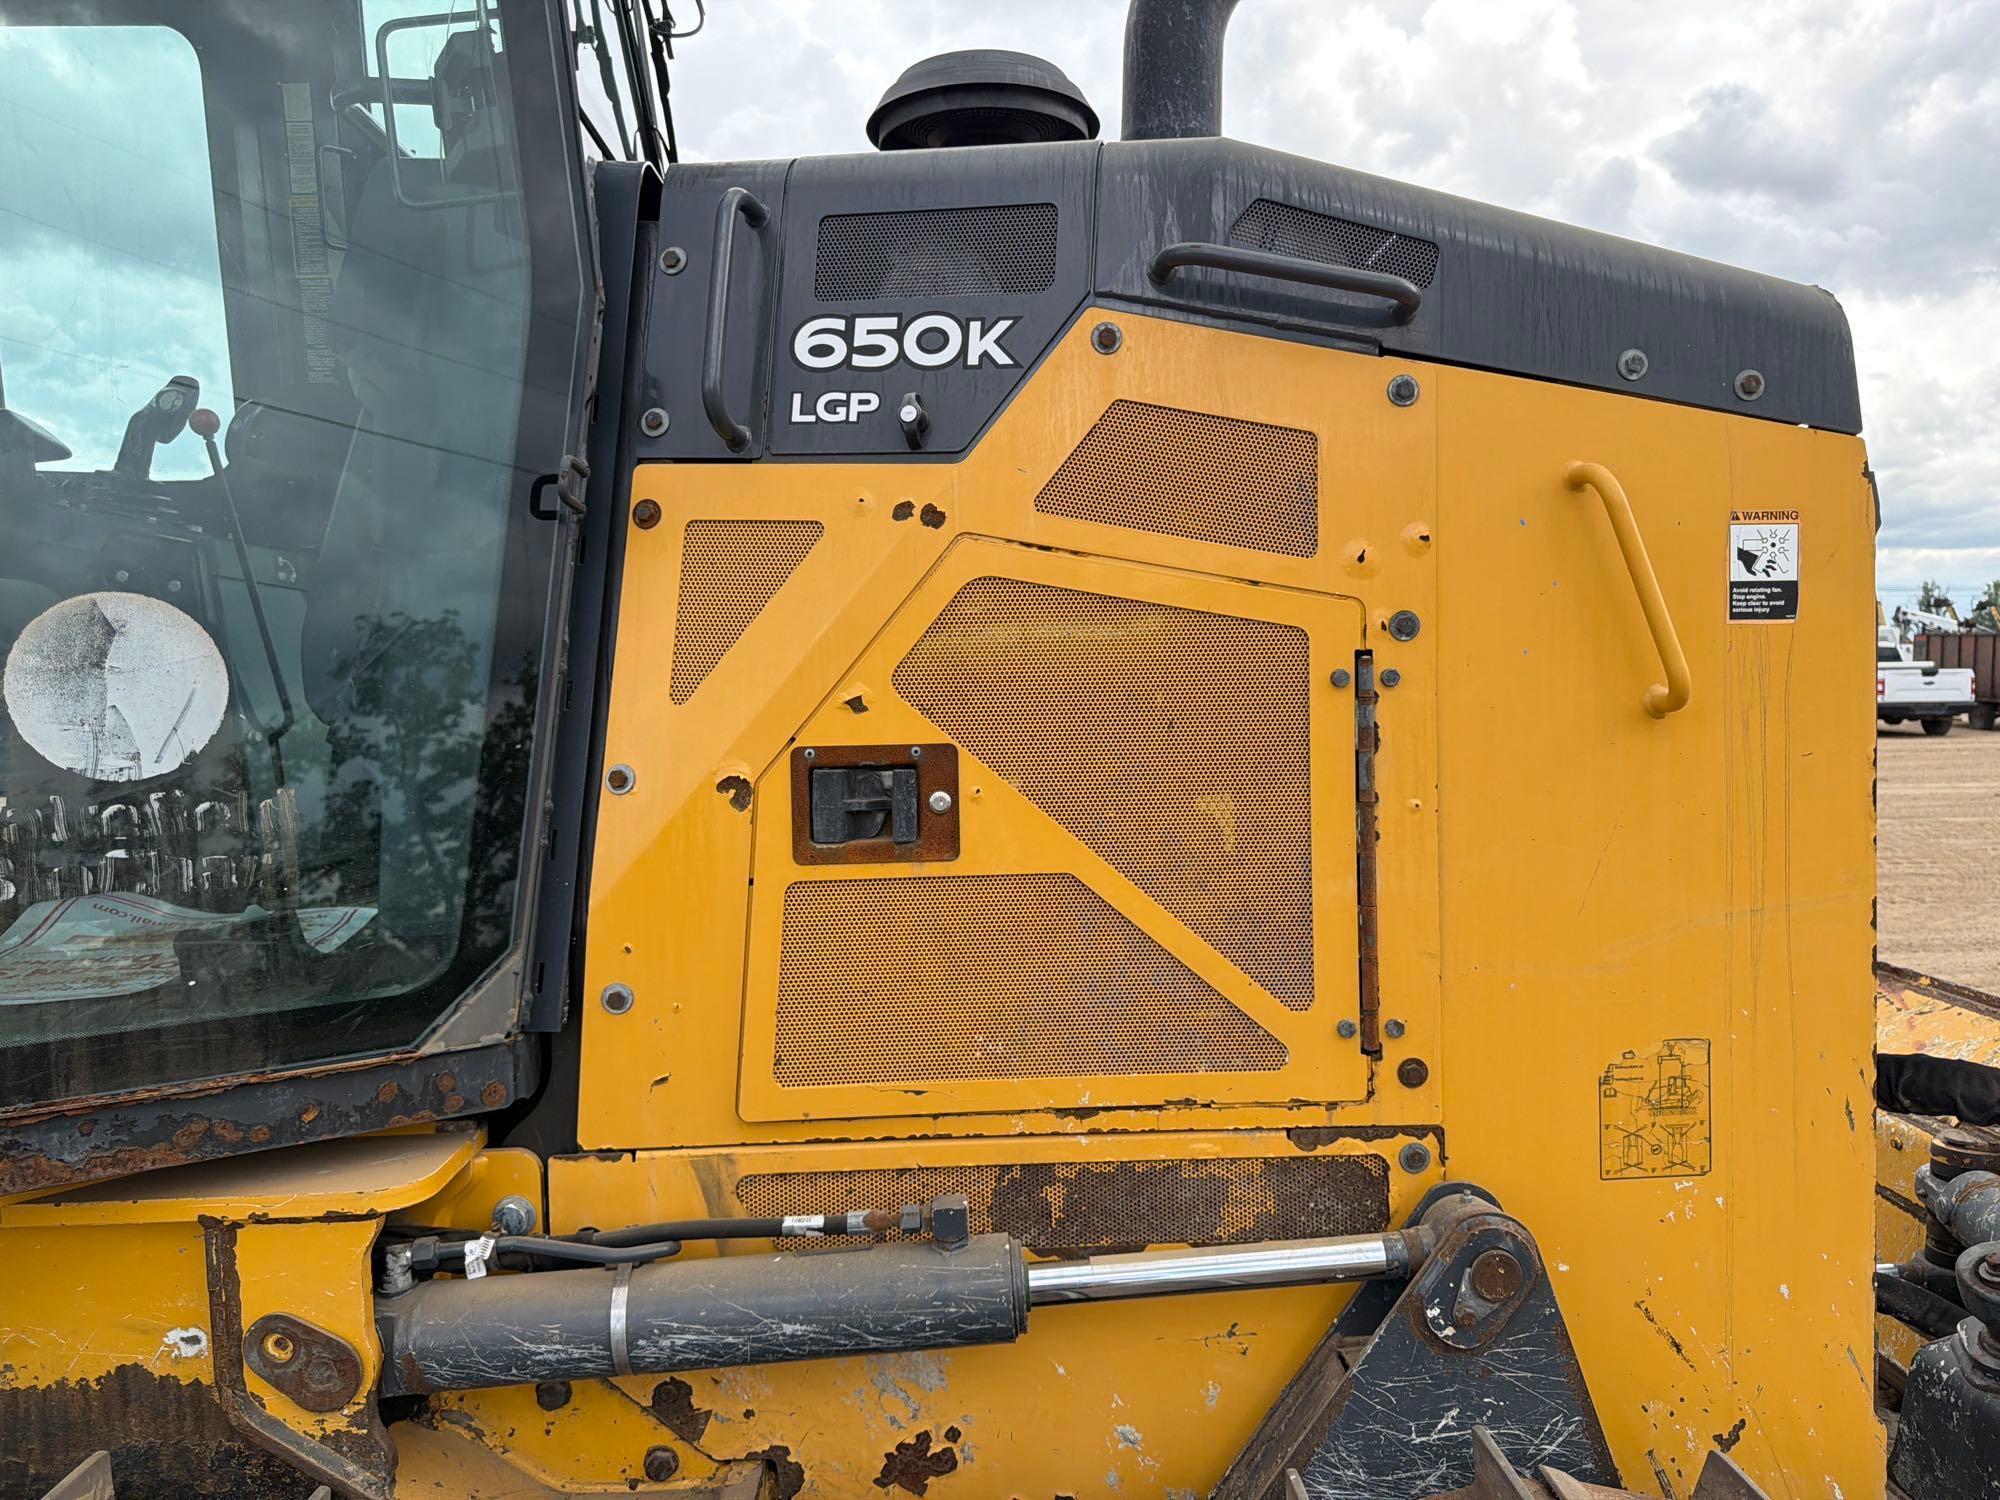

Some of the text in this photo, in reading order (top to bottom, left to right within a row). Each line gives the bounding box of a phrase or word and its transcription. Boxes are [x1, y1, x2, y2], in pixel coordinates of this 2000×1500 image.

[792, 313, 1017, 371] 650K
[790, 391, 881, 424] LGP
[1742, 510, 1799, 521] WARNING
